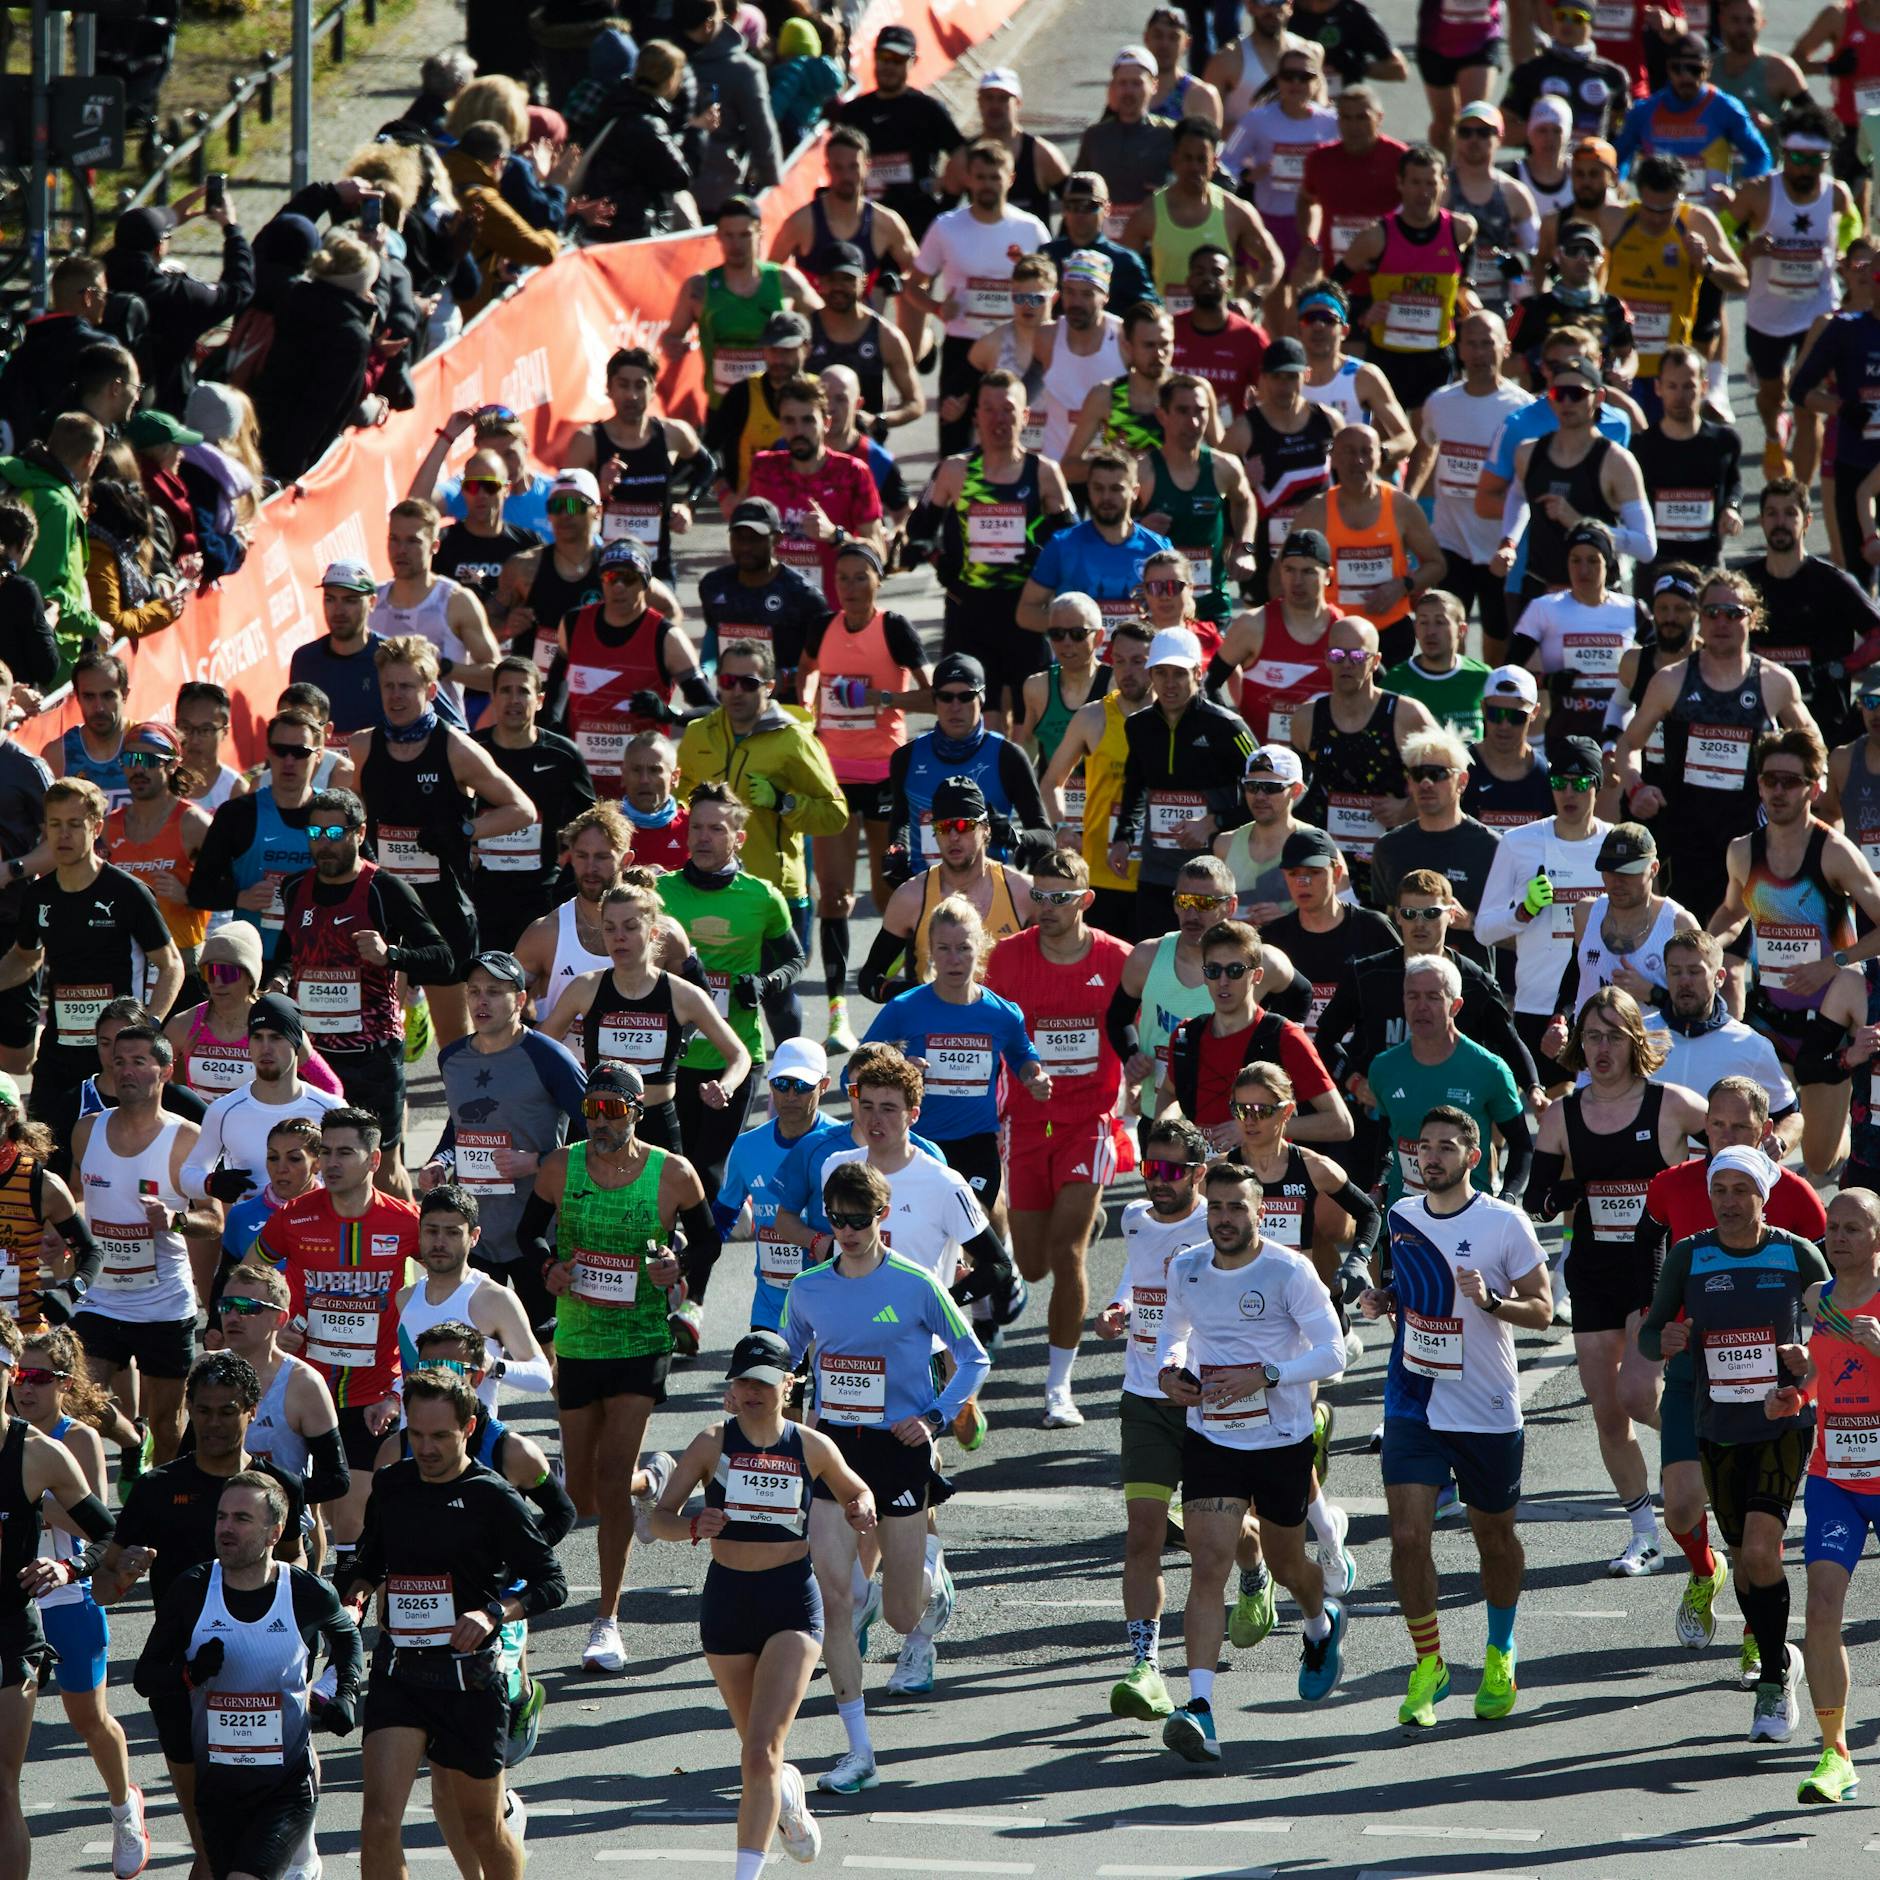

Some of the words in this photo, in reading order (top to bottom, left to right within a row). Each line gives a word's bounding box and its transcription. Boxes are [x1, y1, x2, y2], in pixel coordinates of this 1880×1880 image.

[980, 520, 1014, 529] 32341
[1583, 635, 1620, 644] GENERALI
[1576, 650, 1612, 659] 40752
[591, 723, 631, 731] GENERALI
[1706, 728, 1748, 738] GENERALI
[587, 736, 623, 747] 53598
[1699, 742, 1737, 753] 32053
[417, 774, 438, 783] UVU
[1345, 797, 1371, 806] GENER
[1160, 809, 1193, 818] 27128
[1496, 815, 1538, 823] GENERALI
[1772, 928, 1815, 936] GENERALI
[1767, 942, 1808, 952] 24467
[314, 969, 356, 980] GENERALI
[66, 988, 108, 998] GENERALI
[309, 986, 347, 995] 25440
[64, 1003, 100, 1014] 39091
[617, 1018, 663, 1026] GENERALI
[1050, 1018, 1095, 1028] GENERALI
[613, 1032, 653, 1042] 19723
[944, 1037, 988, 1047] GENERALI
[1046, 1034, 1086, 1044] 36182
[208, 1046, 250, 1057] GENERAL
[939, 1052, 980, 1063] 54021
[202, 1062, 244, 1074] 62043
[466, 1135, 506, 1145] GENERALI
[1283, 1184, 1306, 1196] BRC
[1264, 1201, 1297, 1211] NERALI
[1601, 1199, 1641, 1210] 26261
[104, 1226, 149, 1236] GENERALI
[102, 1241, 140, 1252] 15055
[587, 1255, 634, 1267] GENERALI
[582, 1269, 622, 1284] 23194
[600, 1284, 623, 1292] mirko
[1140, 1292, 1166, 1302] GENER
[328, 1300, 376, 1310] GENERALI
[1138, 1306, 1163, 1319] 5263
[321, 1314, 364, 1326] 18865
[1414, 1318, 1458, 1330] GENERALI
[332, 1326, 353, 1334] ALEX
[1412, 1333, 1446, 1347] 31541
[1721, 1333, 1770, 1343] GENERALI
[1418, 1344, 1438, 1354] Pablo
[1718, 1349, 1762, 1362] 61848
[835, 1360, 880, 1370] GENERALI
[1728, 1363, 1754, 1371] Gianni
[830, 1374, 870, 1388] 24536
[838, 1388, 862, 1397] Xavier
[1837, 1416, 1880, 1426] GENERAL
[1836, 1433, 1878, 1444] 24105
[1848, 1445, 1866, 1453] Ante
[750, 1458, 797, 1473] GENERALI
[742, 1475, 789, 1489] 14393
[755, 1489, 774, 1497] Tess
[400, 1580, 446, 1590] GENERALI
[397, 1597, 438, 1609] 26263
[405, 1611, 430, 1619] Daniel
[224, 1696, 276, 1707] GENERALI
[220, 1714, 266, 1727] 52212
[233, 1728, 252, 1737] Ivan
[232, 1756, 256, 1764] YoPRO
